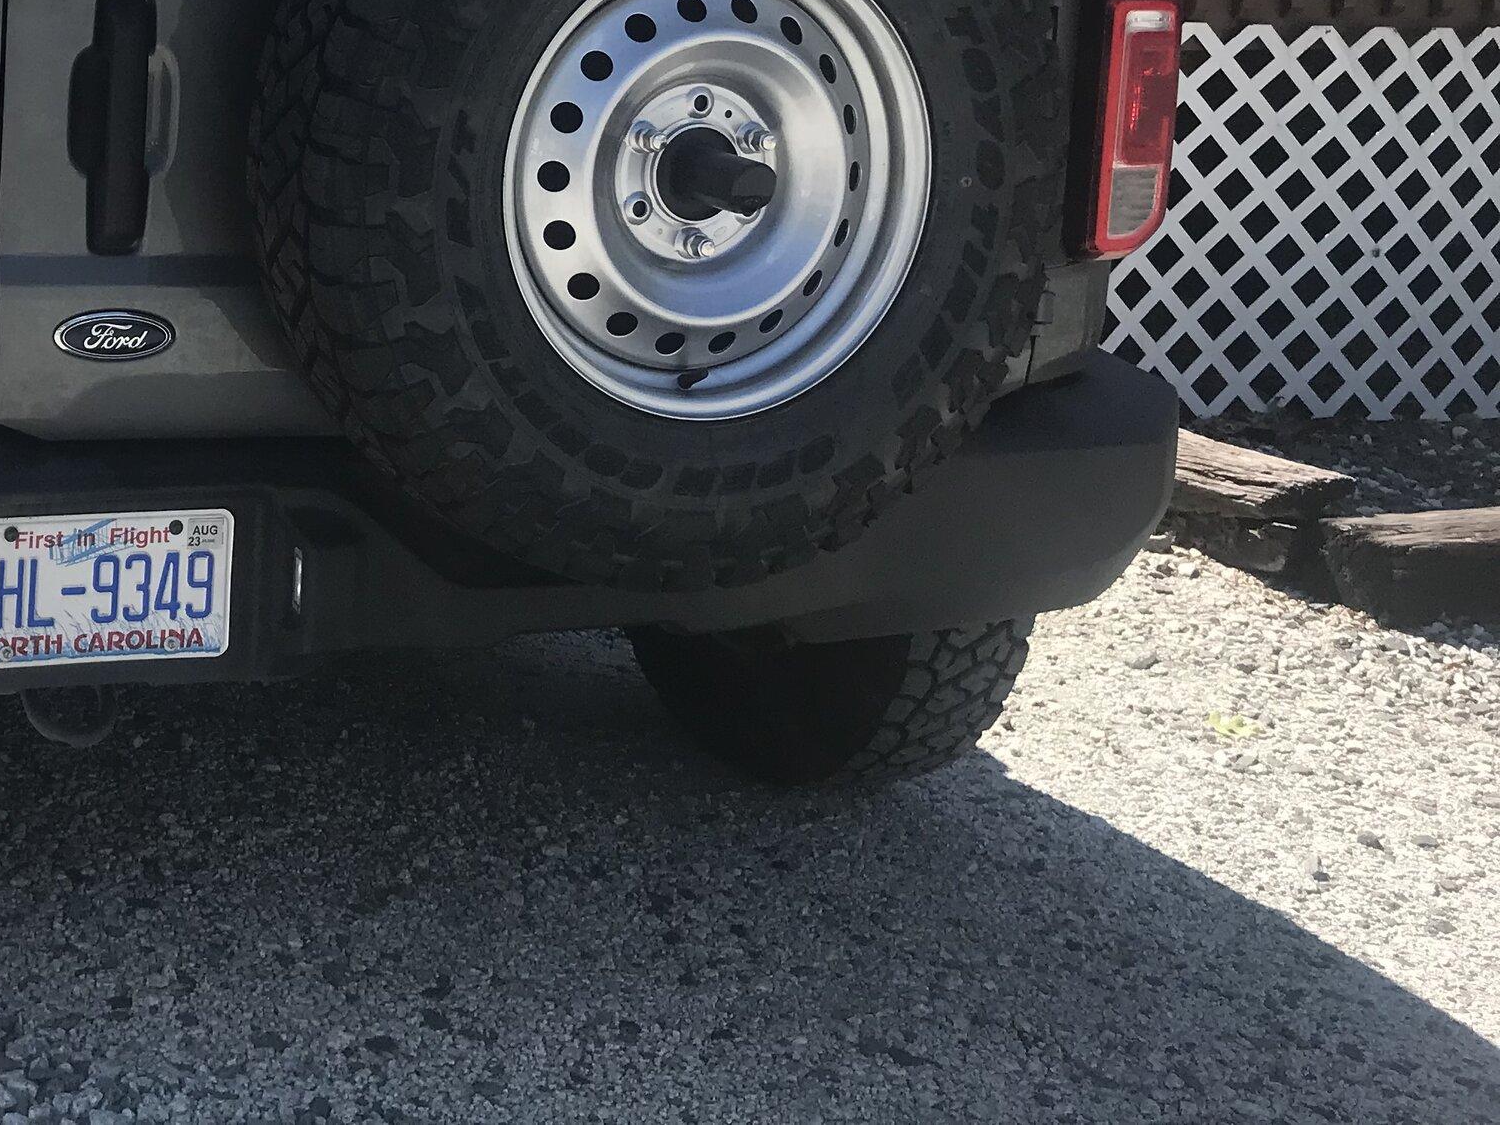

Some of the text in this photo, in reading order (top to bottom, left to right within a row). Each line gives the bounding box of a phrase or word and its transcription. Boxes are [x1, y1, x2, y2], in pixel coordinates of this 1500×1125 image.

[886, 6, 1007, 405] TOYO TIRES
[83, 323, 148, 350] Ford
[453, 273, 663, 492] COUNTRY
[673, 433, 836, 497] OPEN
[14, 530, 64, 550] First
[109, 526, 170, 549] Flight
[188, 536, 201, 547] 23
[192, 525, 218, 535] AUG
[73, 627, 204, 652] CAROLINA
